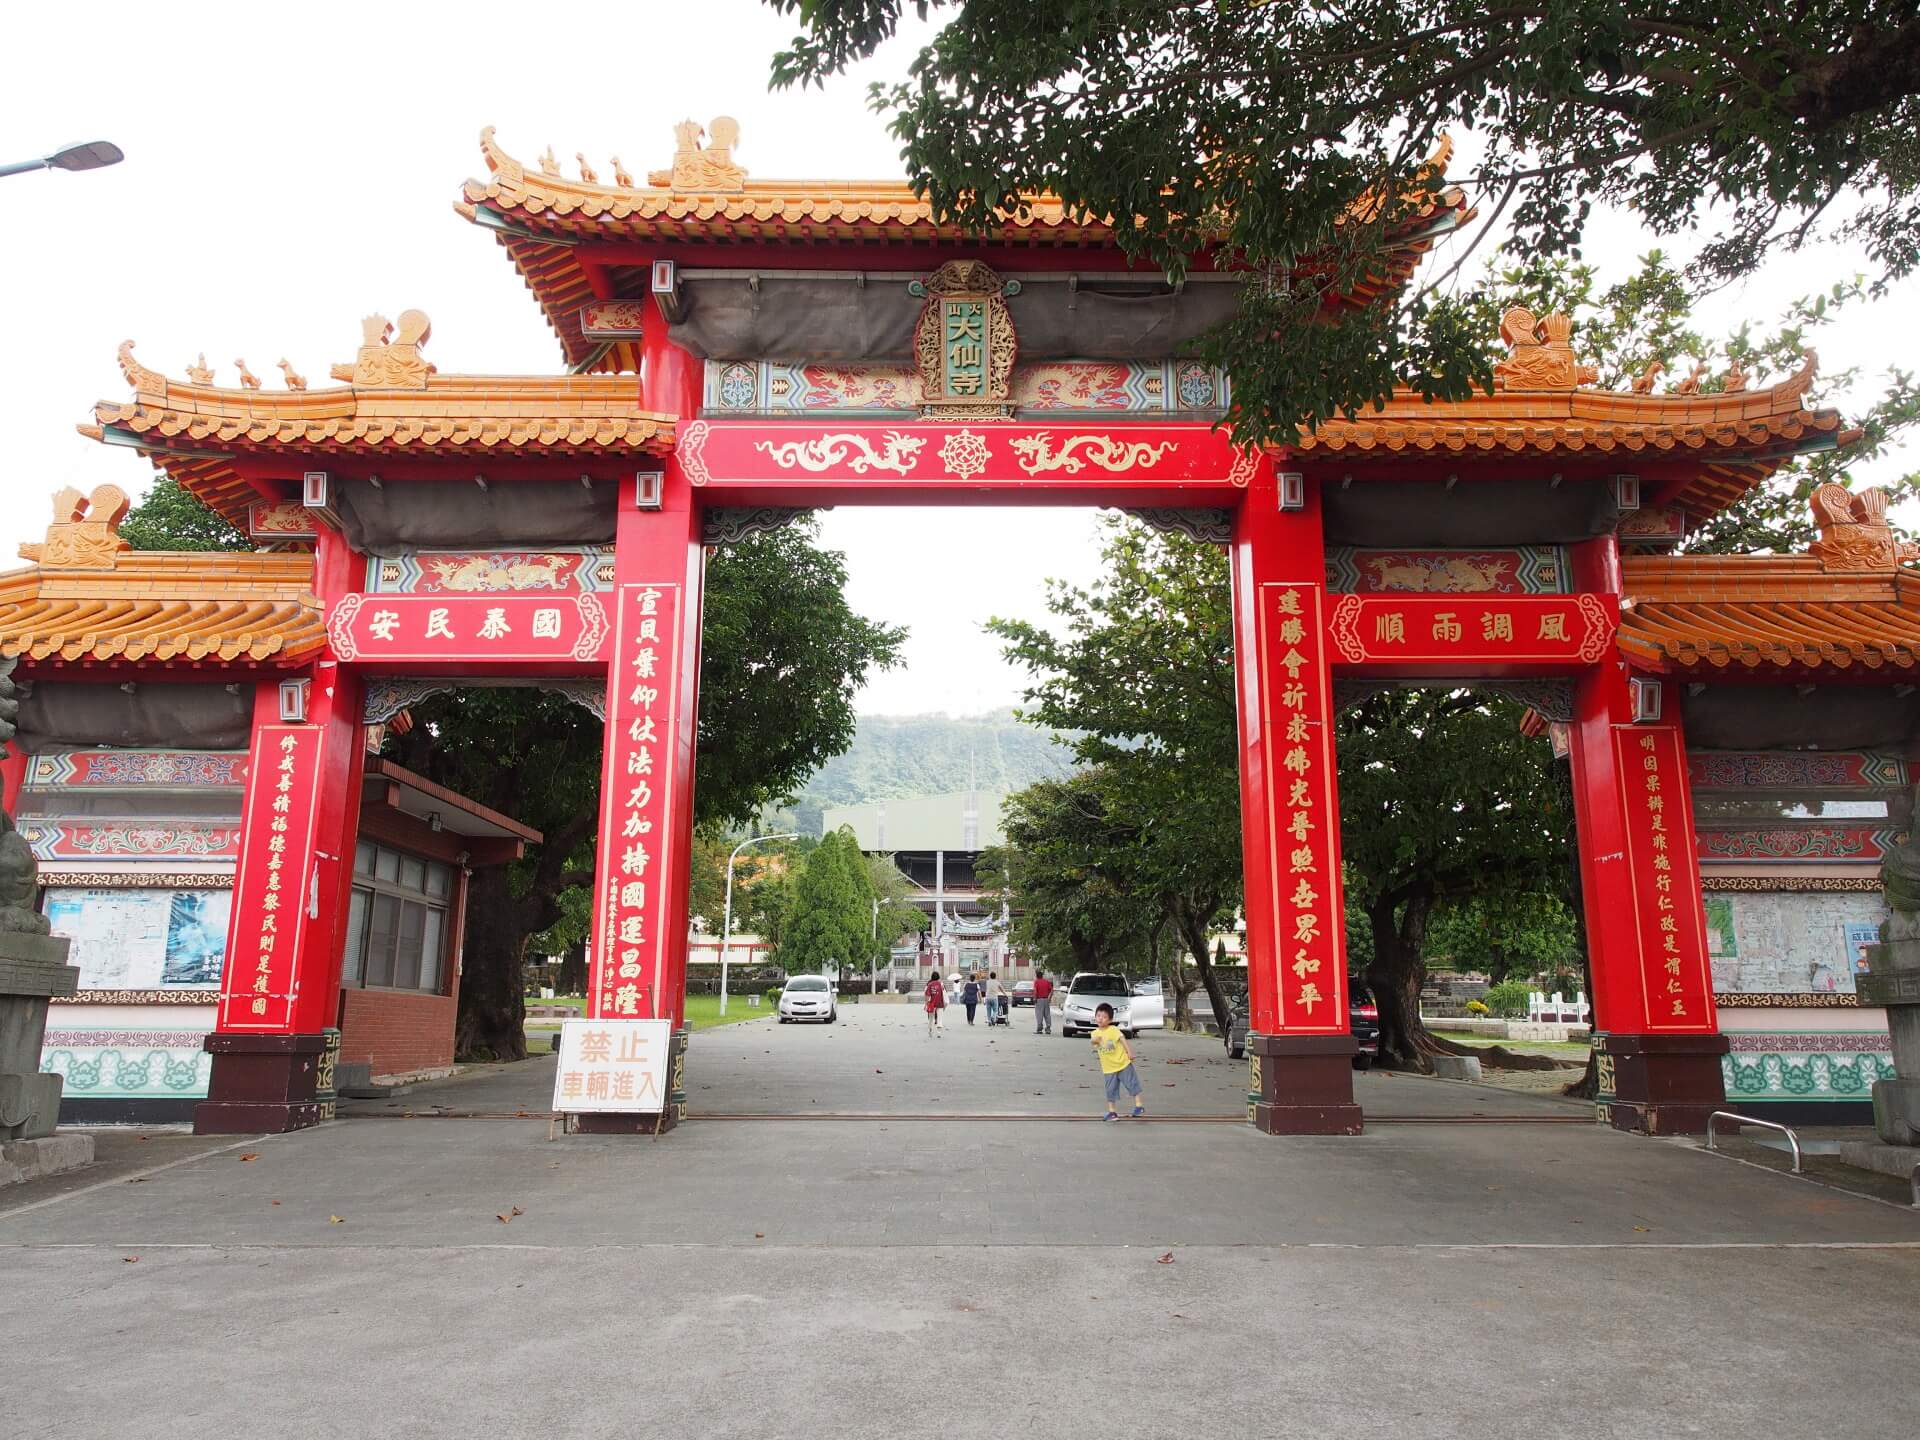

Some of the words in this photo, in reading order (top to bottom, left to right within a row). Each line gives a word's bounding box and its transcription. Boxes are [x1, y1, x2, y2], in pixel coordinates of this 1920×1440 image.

[949, 317, 982, 395] 大仙寺
[368, 607, 562, 641] 國泰民安
[1375, 611, 1571, 644] 風調雨順
[614, 587, 662, 1015] 宣貝葉仰仗法力加持國運昌隆
[1277, 589, 1323, 1015] 建勝會祈求佛光普照世界和平
[579, 1030, 648, 1063] 禁止
[561, 1070, 659, 1103] 車輛進入
